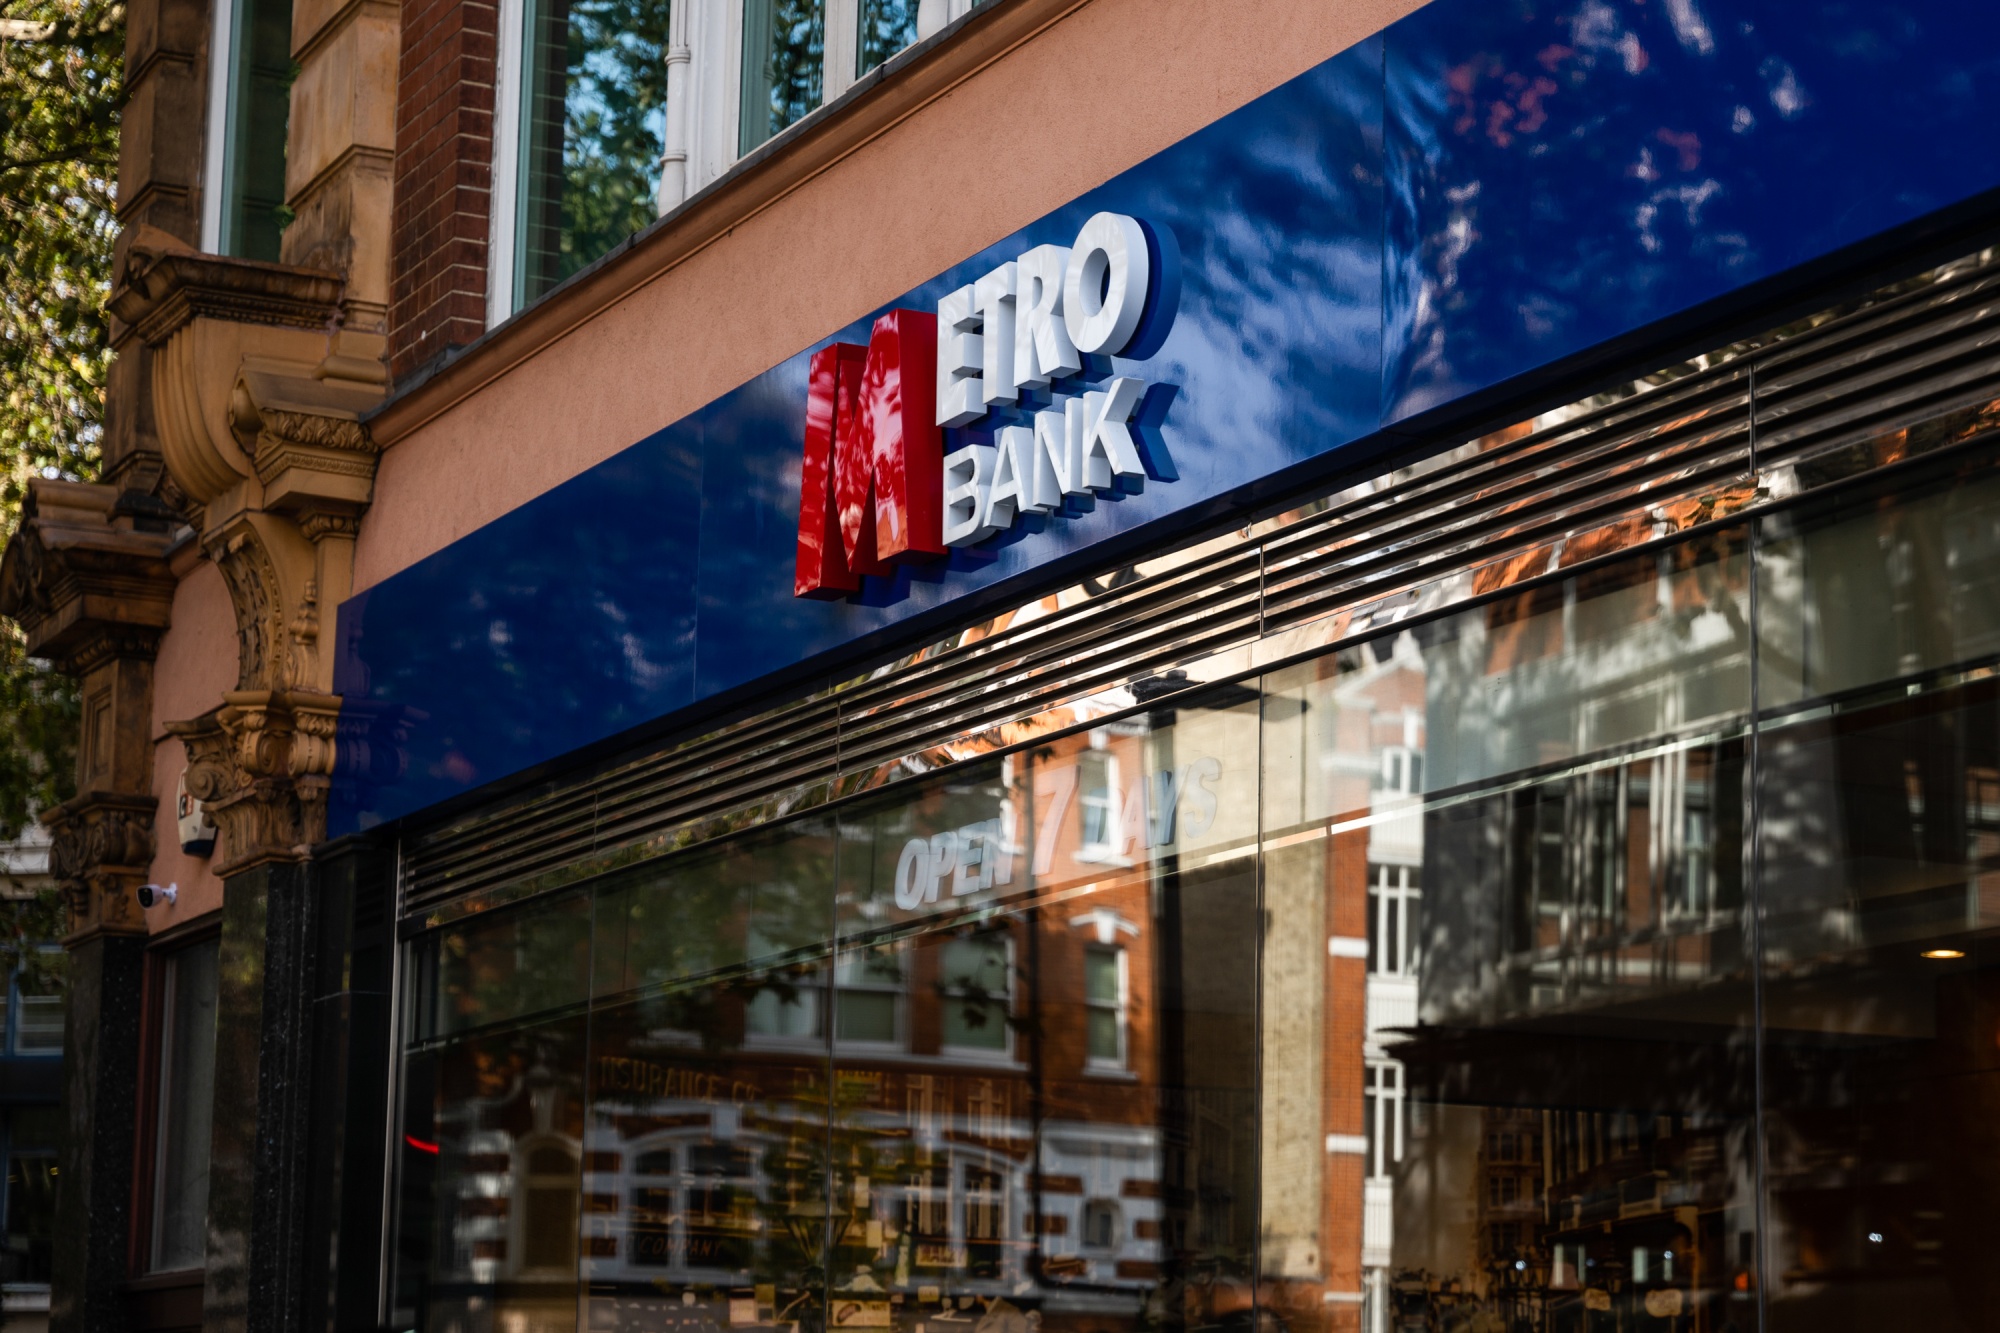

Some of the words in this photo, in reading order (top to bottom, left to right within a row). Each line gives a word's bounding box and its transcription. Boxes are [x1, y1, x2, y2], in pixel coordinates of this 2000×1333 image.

[794, 211, 1150, 599] METRO
[943, 377, 1145, 548] BANK
[894, 812, 1015, 911] OPEN
[1031, 764, 1082, 877] 7
